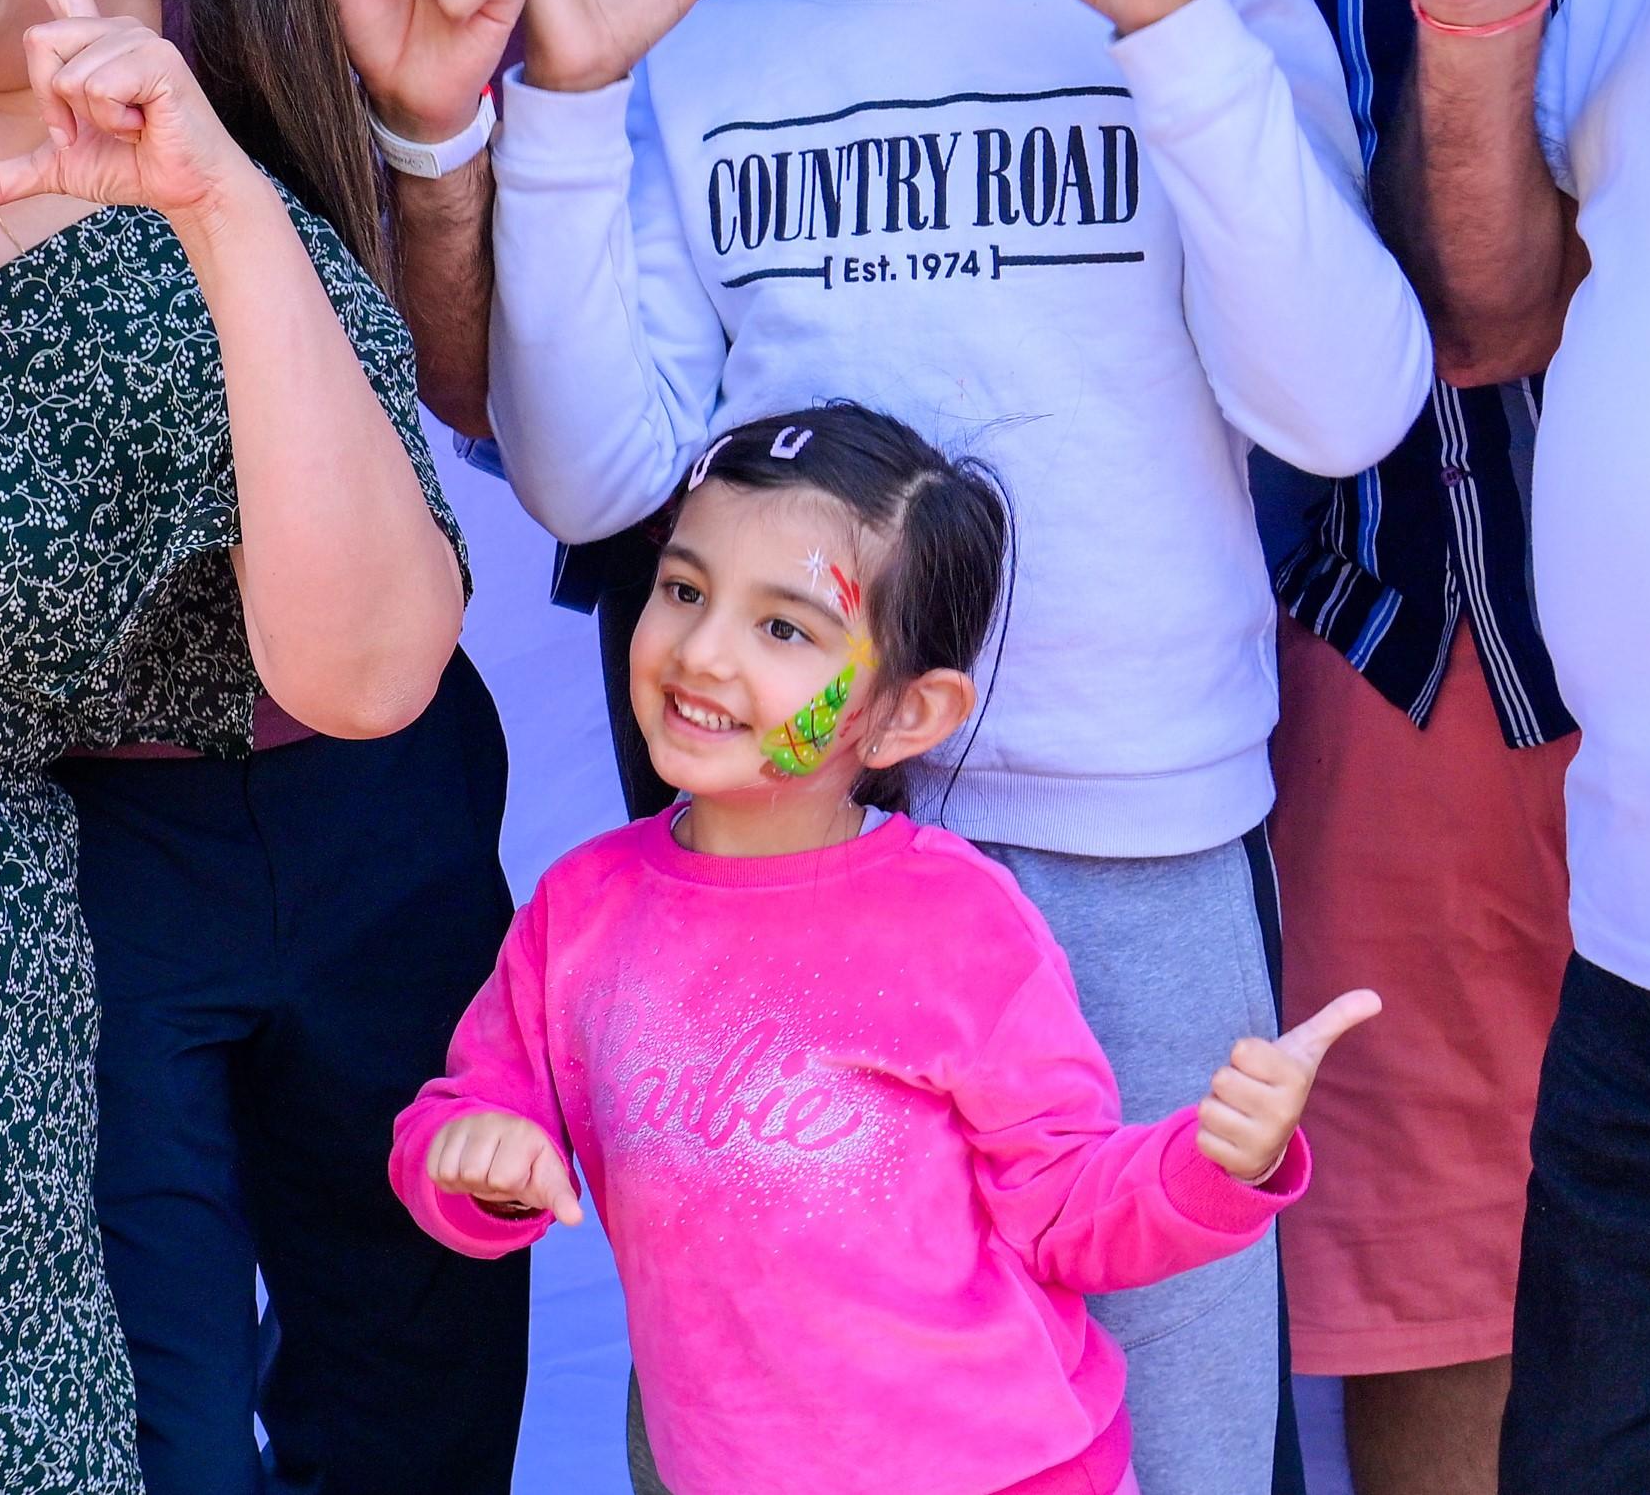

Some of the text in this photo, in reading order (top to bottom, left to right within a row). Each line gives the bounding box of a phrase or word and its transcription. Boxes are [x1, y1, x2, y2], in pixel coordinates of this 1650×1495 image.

[708, 125, 1139, 255] COUNTRY ROAD
[843, 250, 981, 283] Est. 1974
